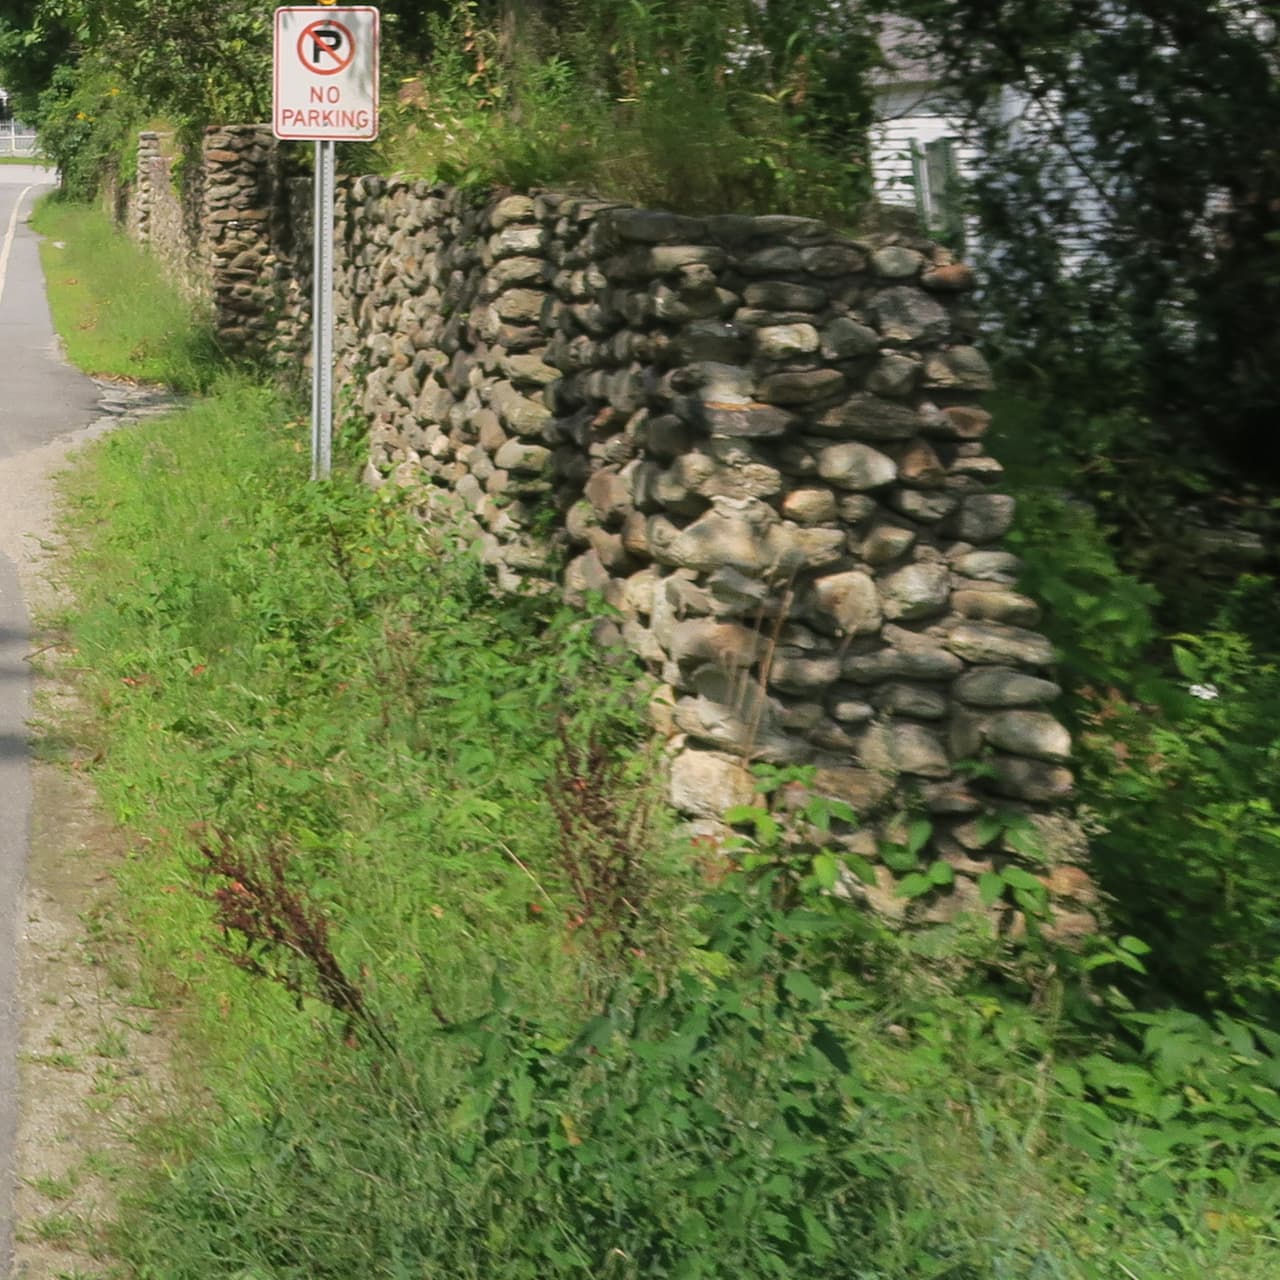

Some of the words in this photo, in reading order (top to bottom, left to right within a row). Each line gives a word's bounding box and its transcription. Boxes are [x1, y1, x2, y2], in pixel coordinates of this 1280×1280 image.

[313, 30, 342, 63] P
[309, 86, 340, 104] NO
[282, 109, 369, 128] PARKING
